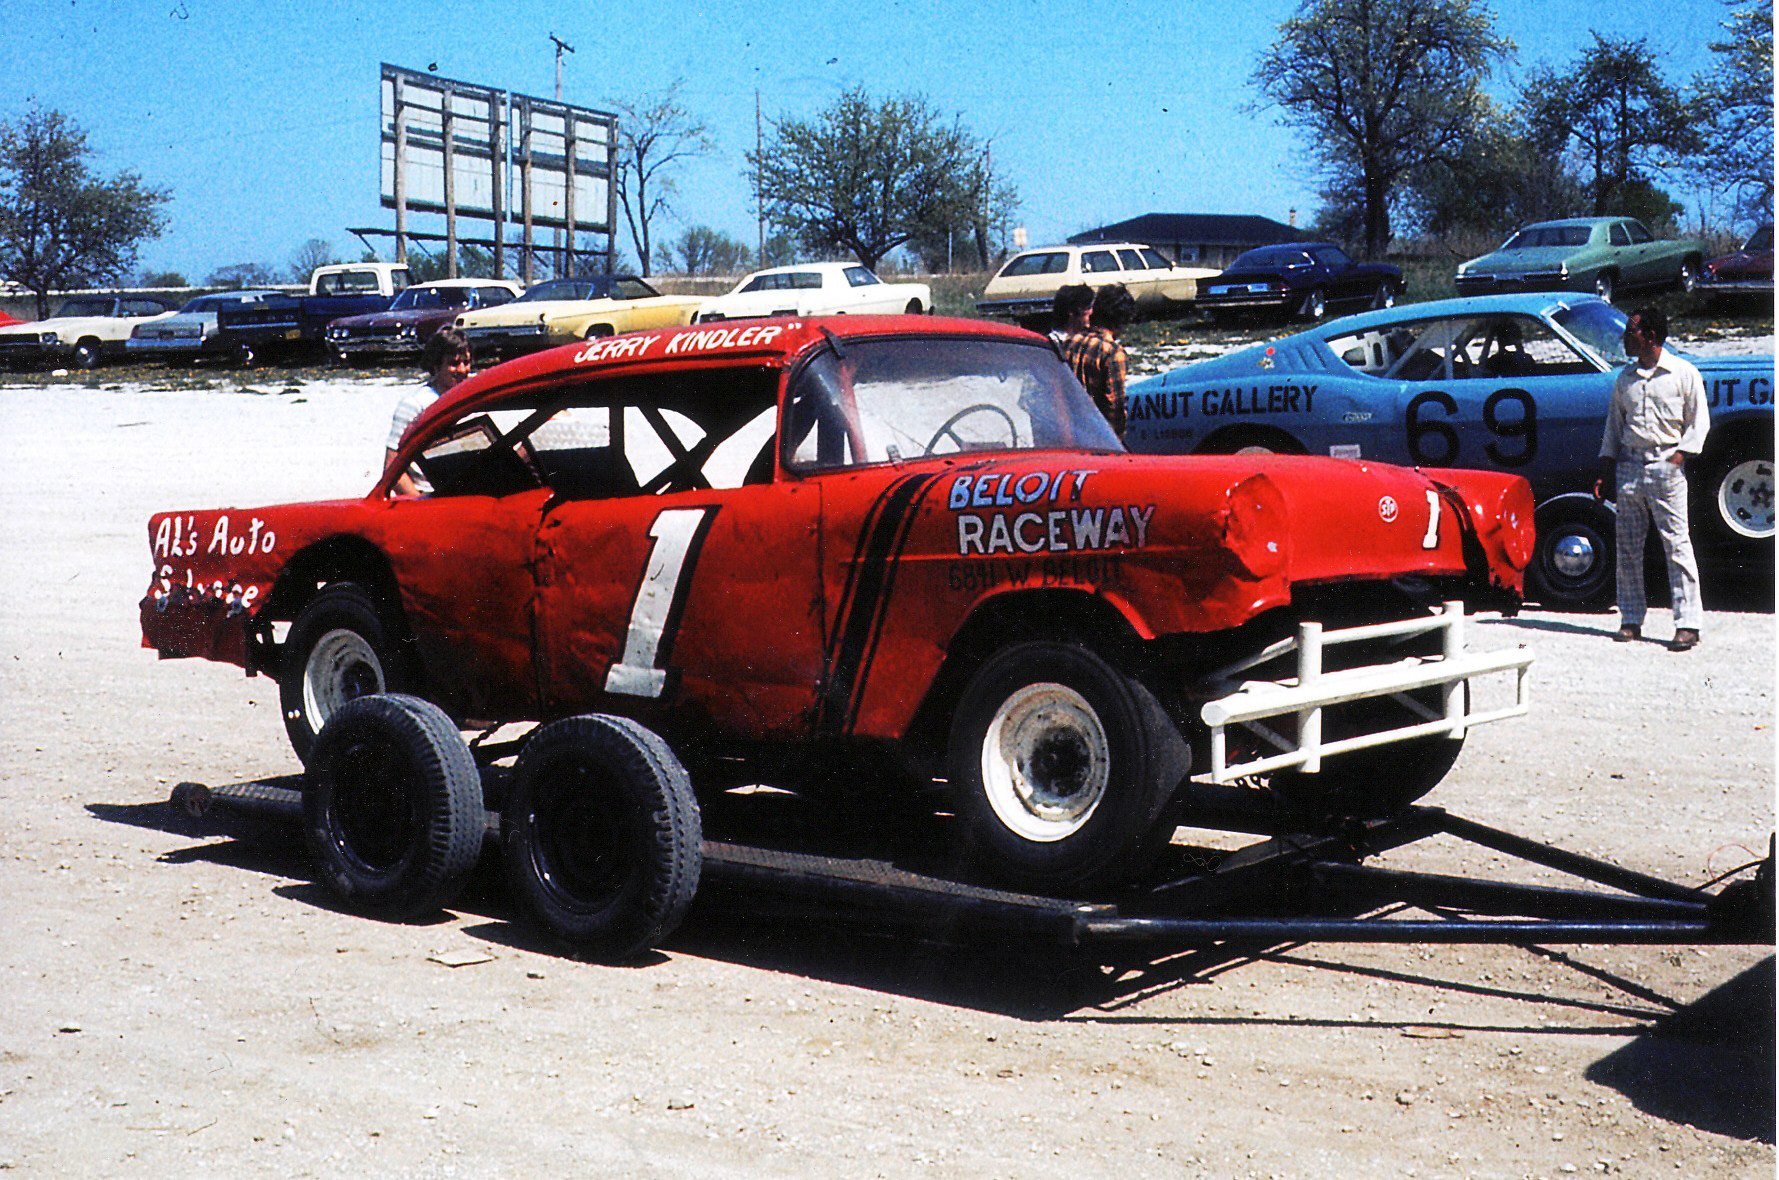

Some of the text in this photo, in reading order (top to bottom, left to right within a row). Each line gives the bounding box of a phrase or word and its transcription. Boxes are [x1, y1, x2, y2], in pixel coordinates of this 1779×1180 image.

[1125, 385, 1318, 421] ANUT GALLERY
[1405, 387, 1538, 467] 69
[949, 469, 1099, 510] BELOIT
[207, 515, 276, 556] Auto
[957, 504, 1156, 555] RACEWAY
[1423, 489, 1440, 550] 1
[602, 506, 711, 702] 1
